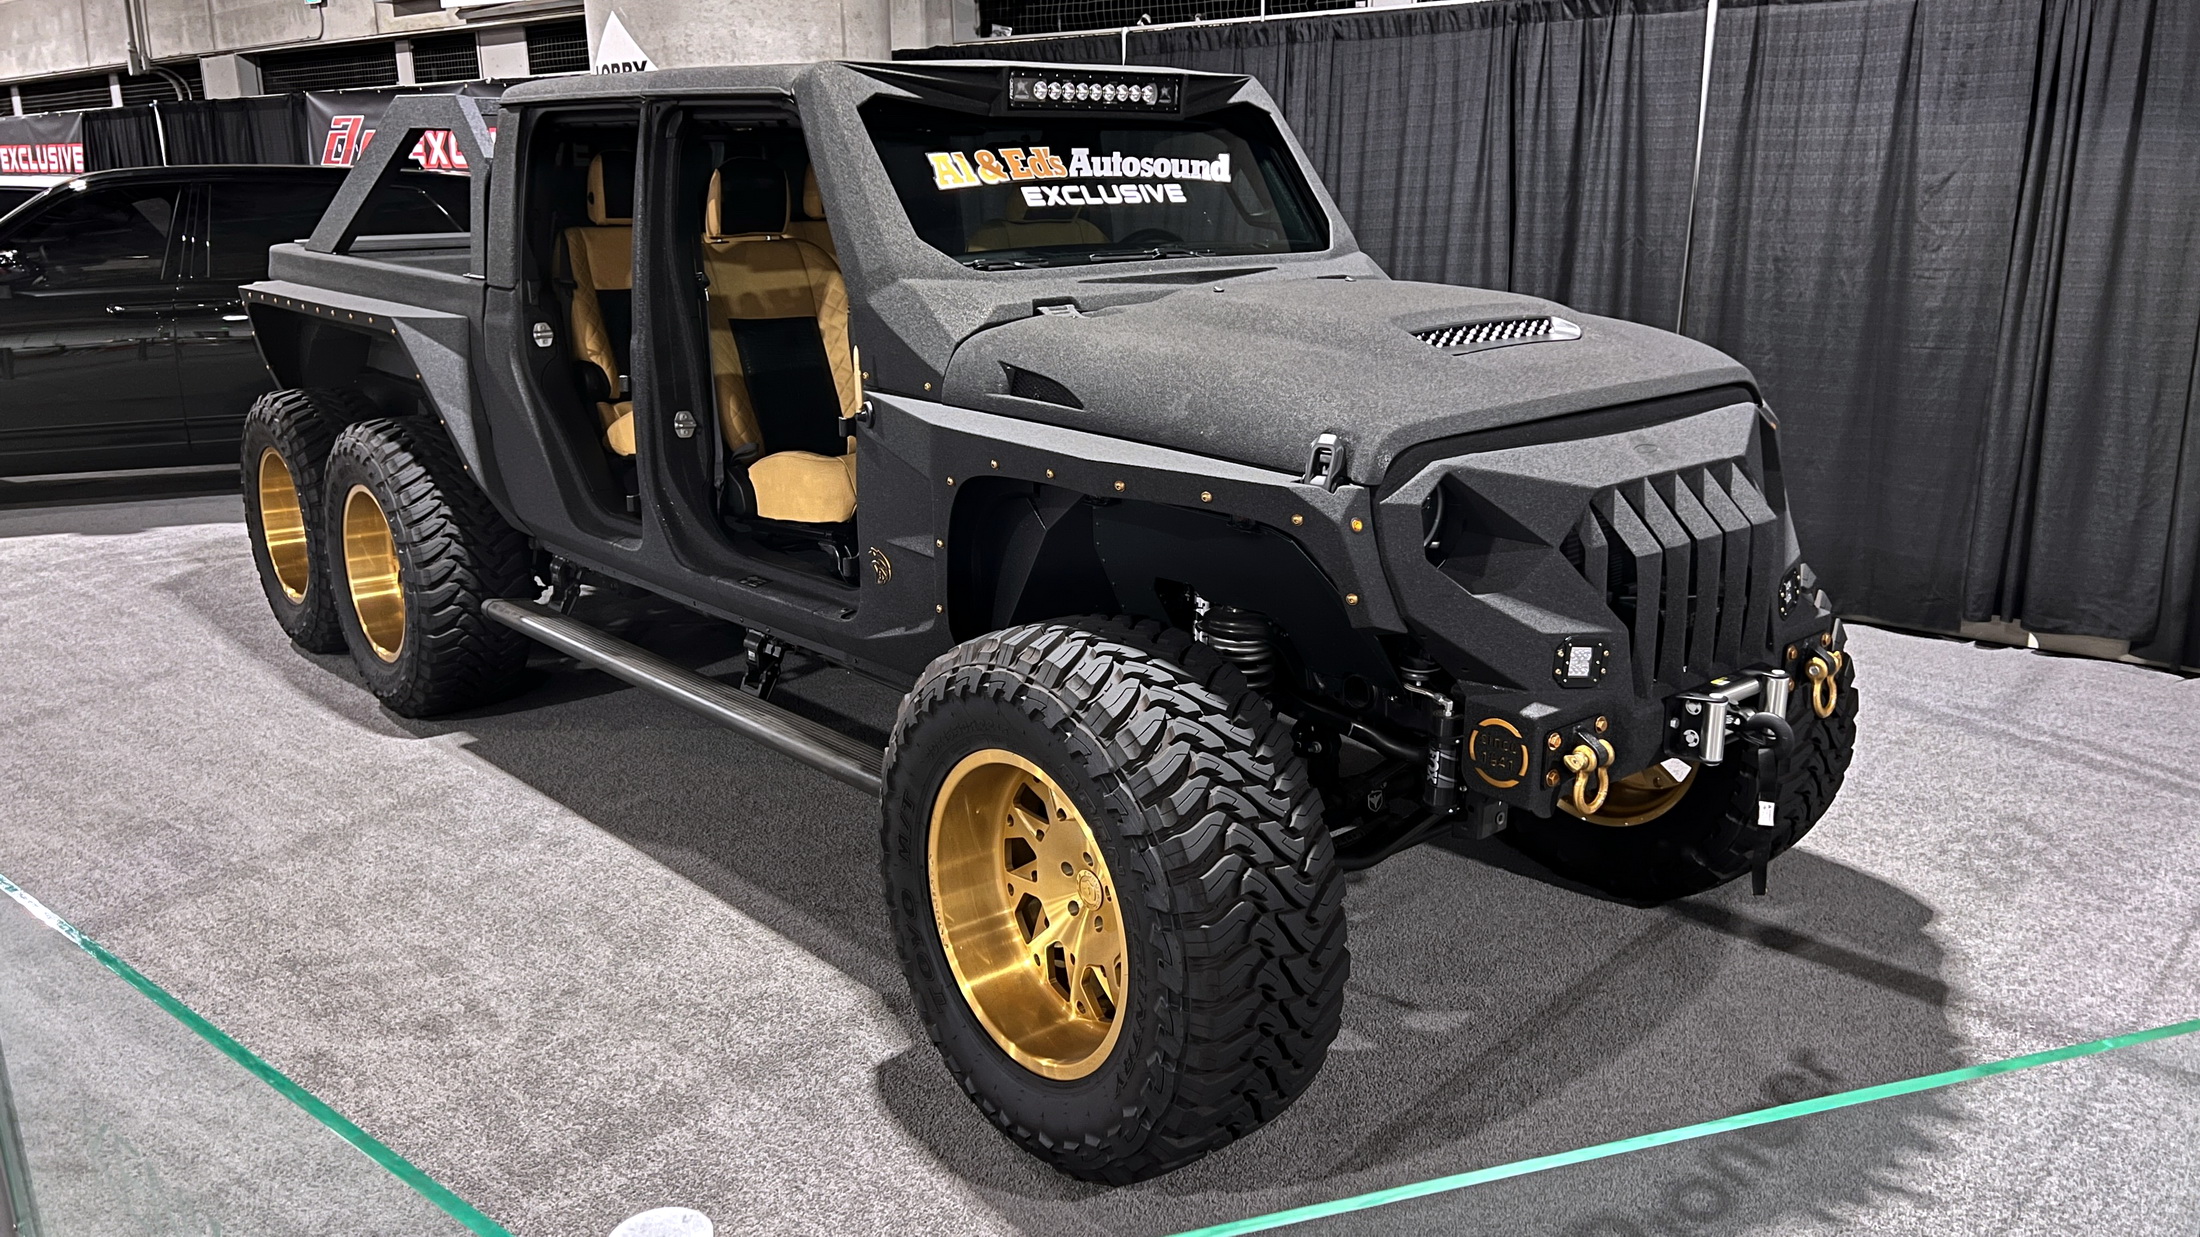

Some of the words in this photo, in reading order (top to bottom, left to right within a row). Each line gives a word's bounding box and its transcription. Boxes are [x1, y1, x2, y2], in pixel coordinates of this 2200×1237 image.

[0, 144, 84, 173] EXCLUSIVE
[1069, 148, 1232, 183] Autosound
[1020, 183, 1187, 207] EXCLUSIVE
[1426, 747, 1440, 785] FOX
[898, 788, 915, 864] M/T
[901, 887, 947, 1014] TOYO
